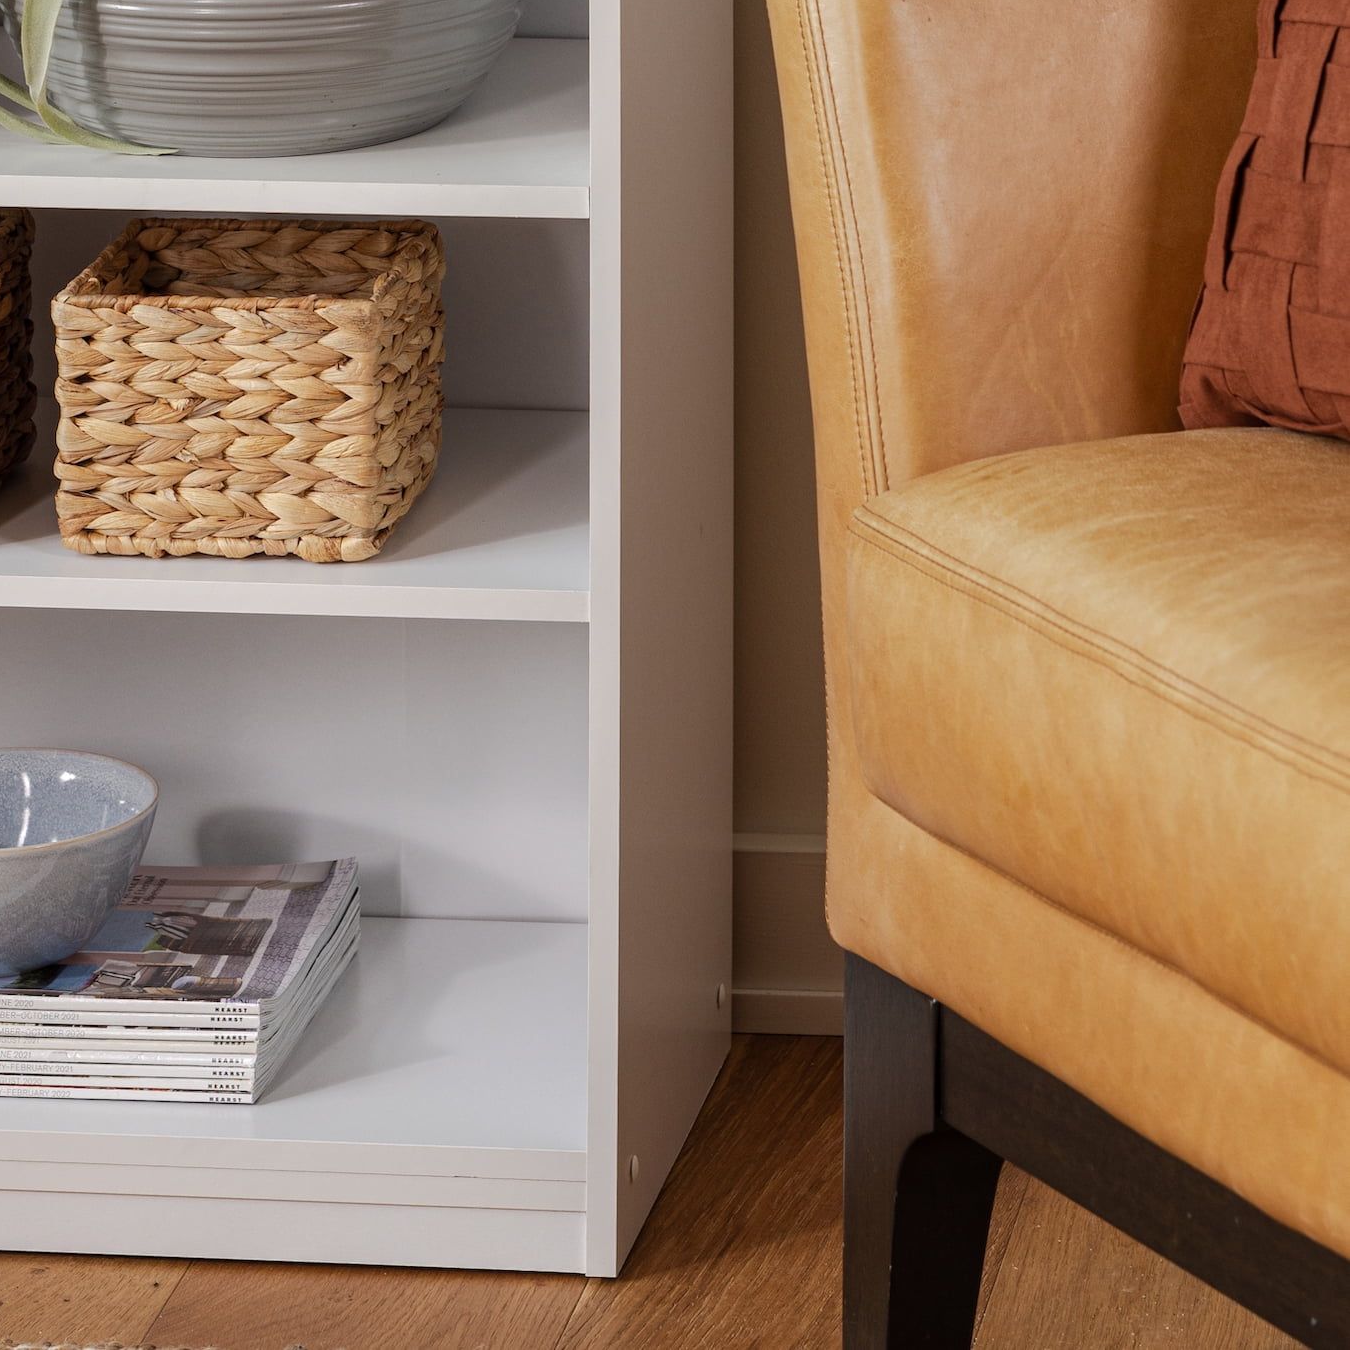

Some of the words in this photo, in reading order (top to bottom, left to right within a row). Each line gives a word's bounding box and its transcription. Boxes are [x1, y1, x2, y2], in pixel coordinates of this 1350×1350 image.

[14, 999, 34, 1008] 2020
[55, 1065, 73, 1073] 2021
[51, 1089, 71, 1098] 2022
